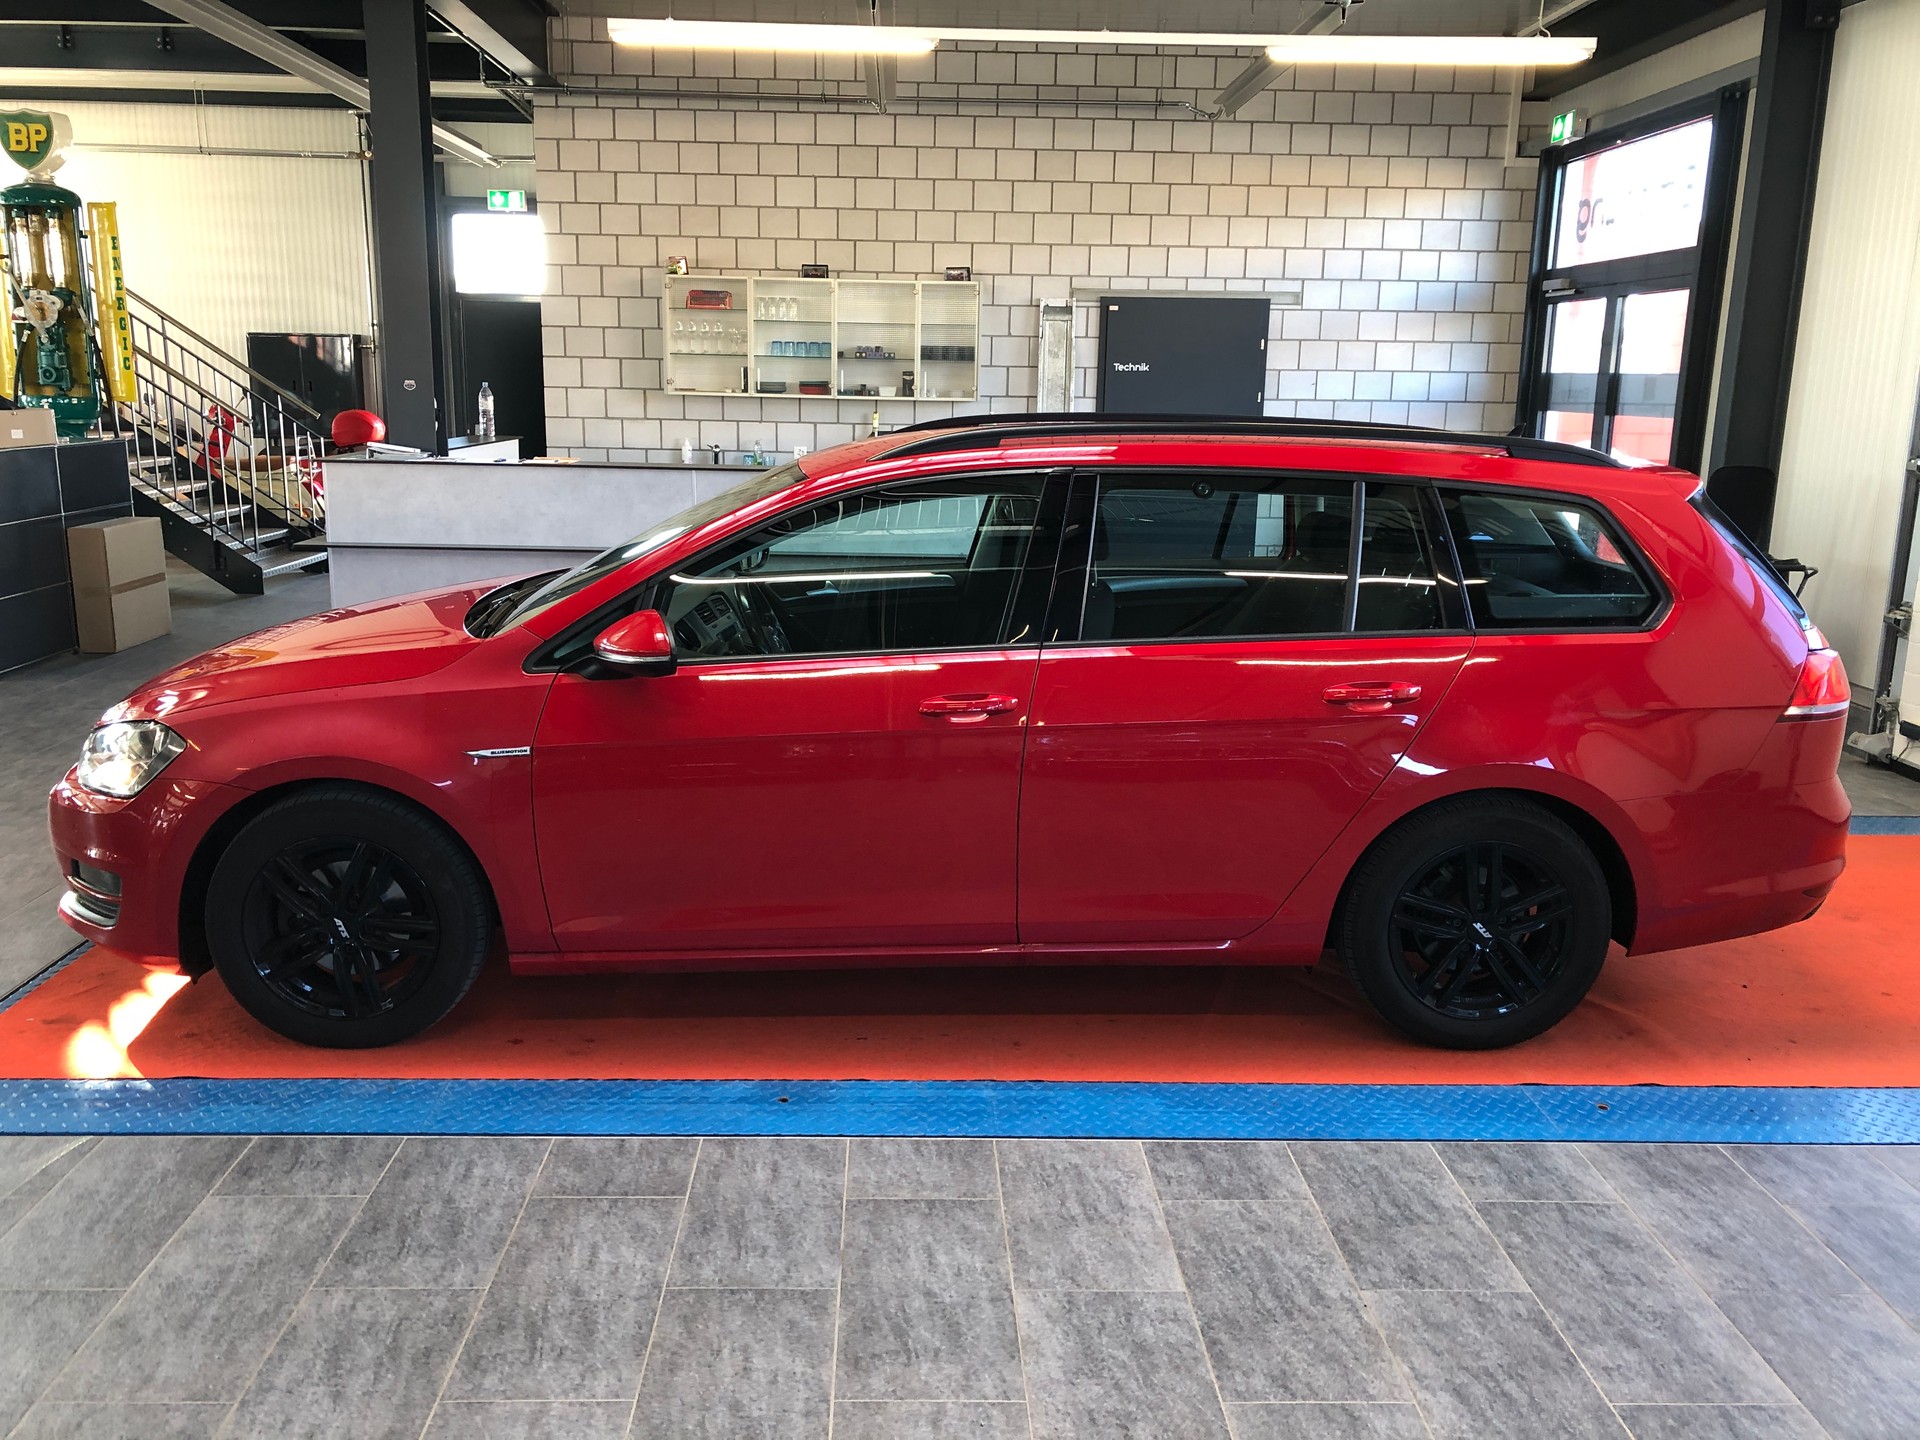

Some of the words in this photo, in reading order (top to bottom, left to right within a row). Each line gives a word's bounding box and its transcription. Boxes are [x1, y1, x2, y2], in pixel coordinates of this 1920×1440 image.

[6, 122, 48, 153] BP
[111, 236, 131, 371] ENERGIC
[1113, 362, 1150, 372] Technik
